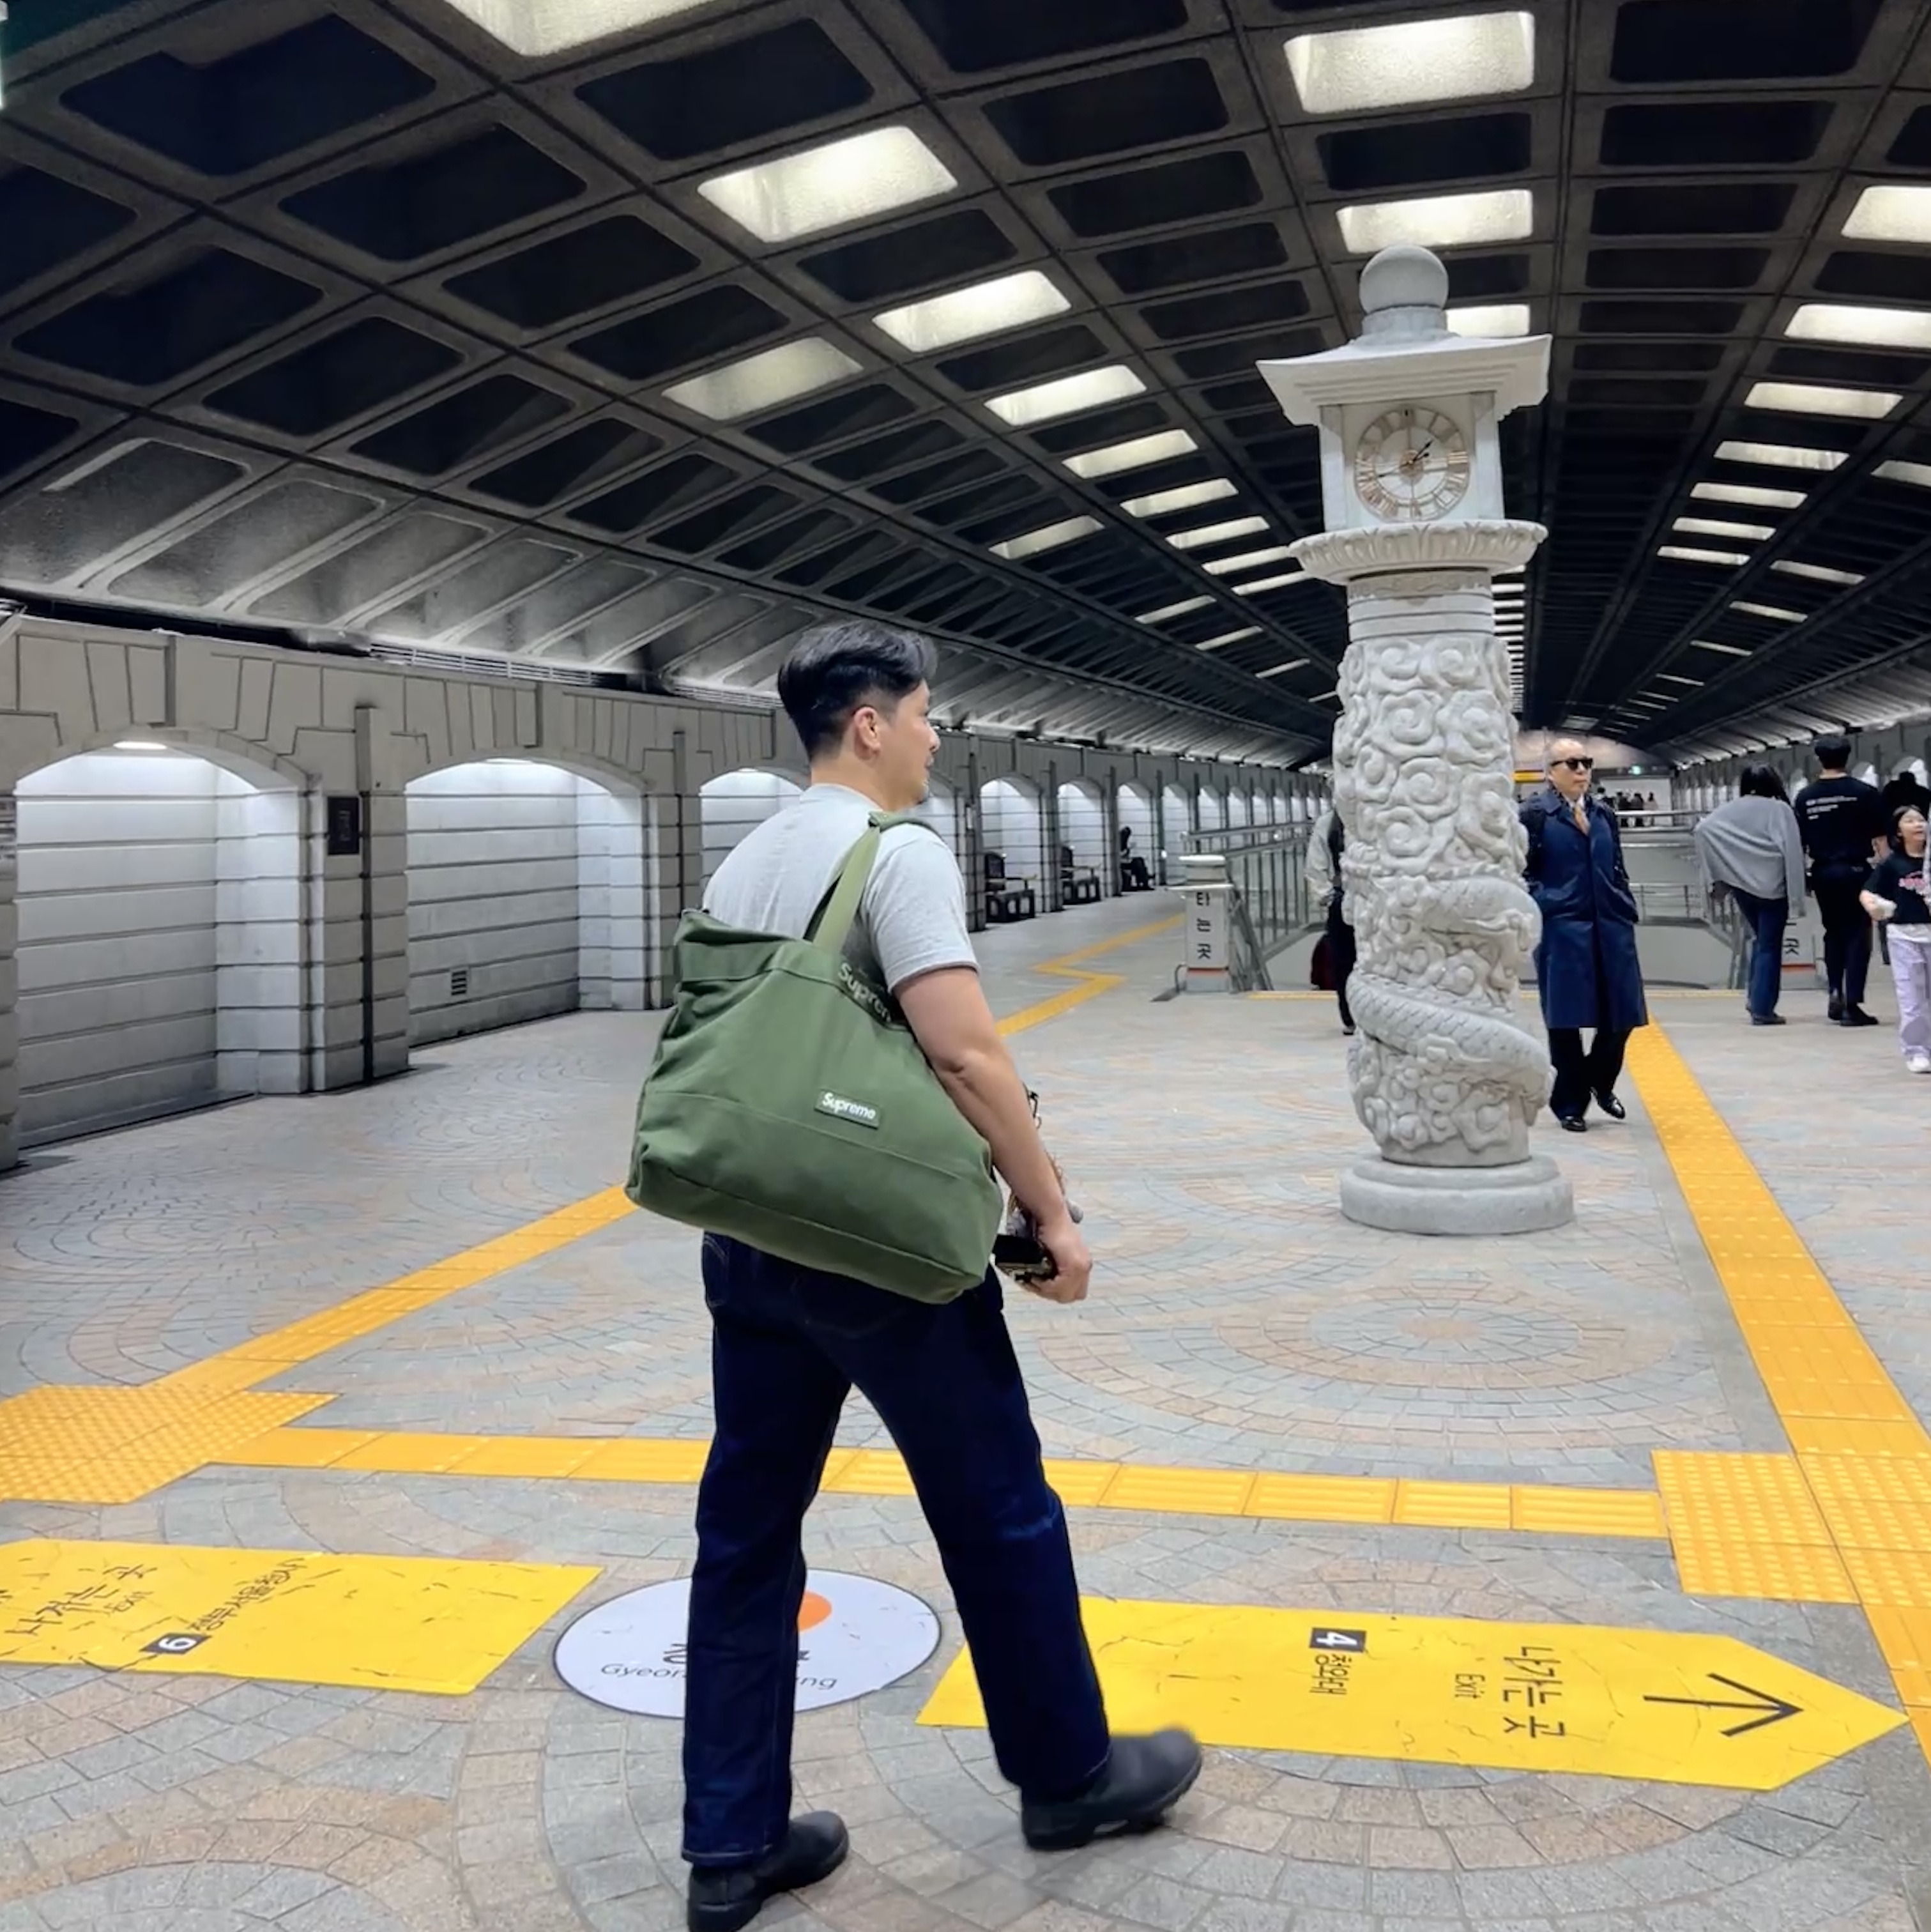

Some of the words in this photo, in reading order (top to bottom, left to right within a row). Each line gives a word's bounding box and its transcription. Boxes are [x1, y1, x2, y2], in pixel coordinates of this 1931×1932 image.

[838, 962, 892, 1022] Supre
[822, 1092, 876, 1119] Supreme
[158, 1637, 197, 1651] 6
[1316, 1631, 1357, 1646] 4
[1309, 1653, 1352, 1695] 청와대
[1454, 1673, 1485, 1698] Exit
[1504, 1646, 1563, 1708] 나가는
[1504, 1715, 1566, 1738] 곳
